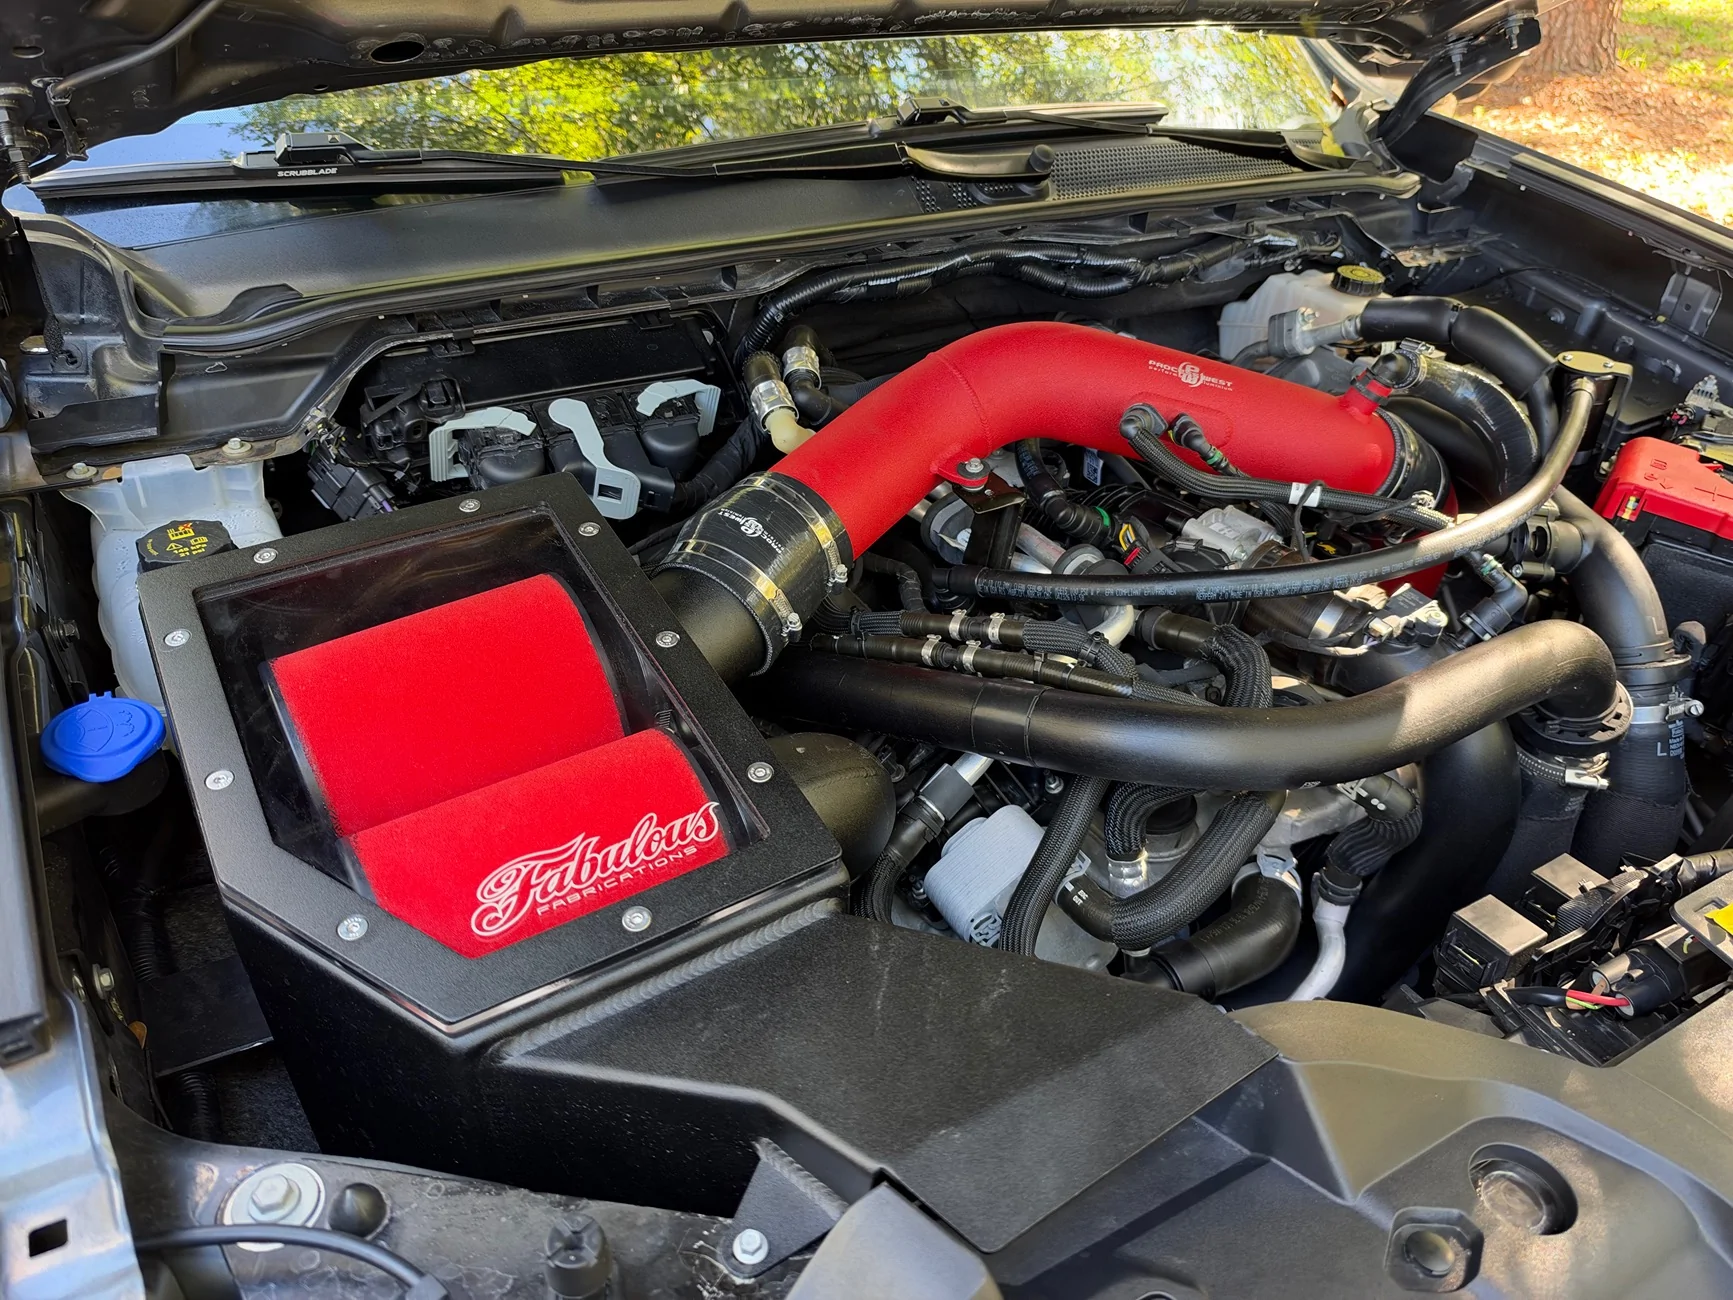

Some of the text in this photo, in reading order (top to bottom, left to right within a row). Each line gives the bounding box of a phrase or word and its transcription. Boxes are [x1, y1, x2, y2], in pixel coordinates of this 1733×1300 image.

[277, 168, 338, 177] SCRUBBLADE
[1656, 742, 1668, 756] L
[471, 801, 720, 936] Fabulous
[537, 846, 698, 916] FABRICATIONS
